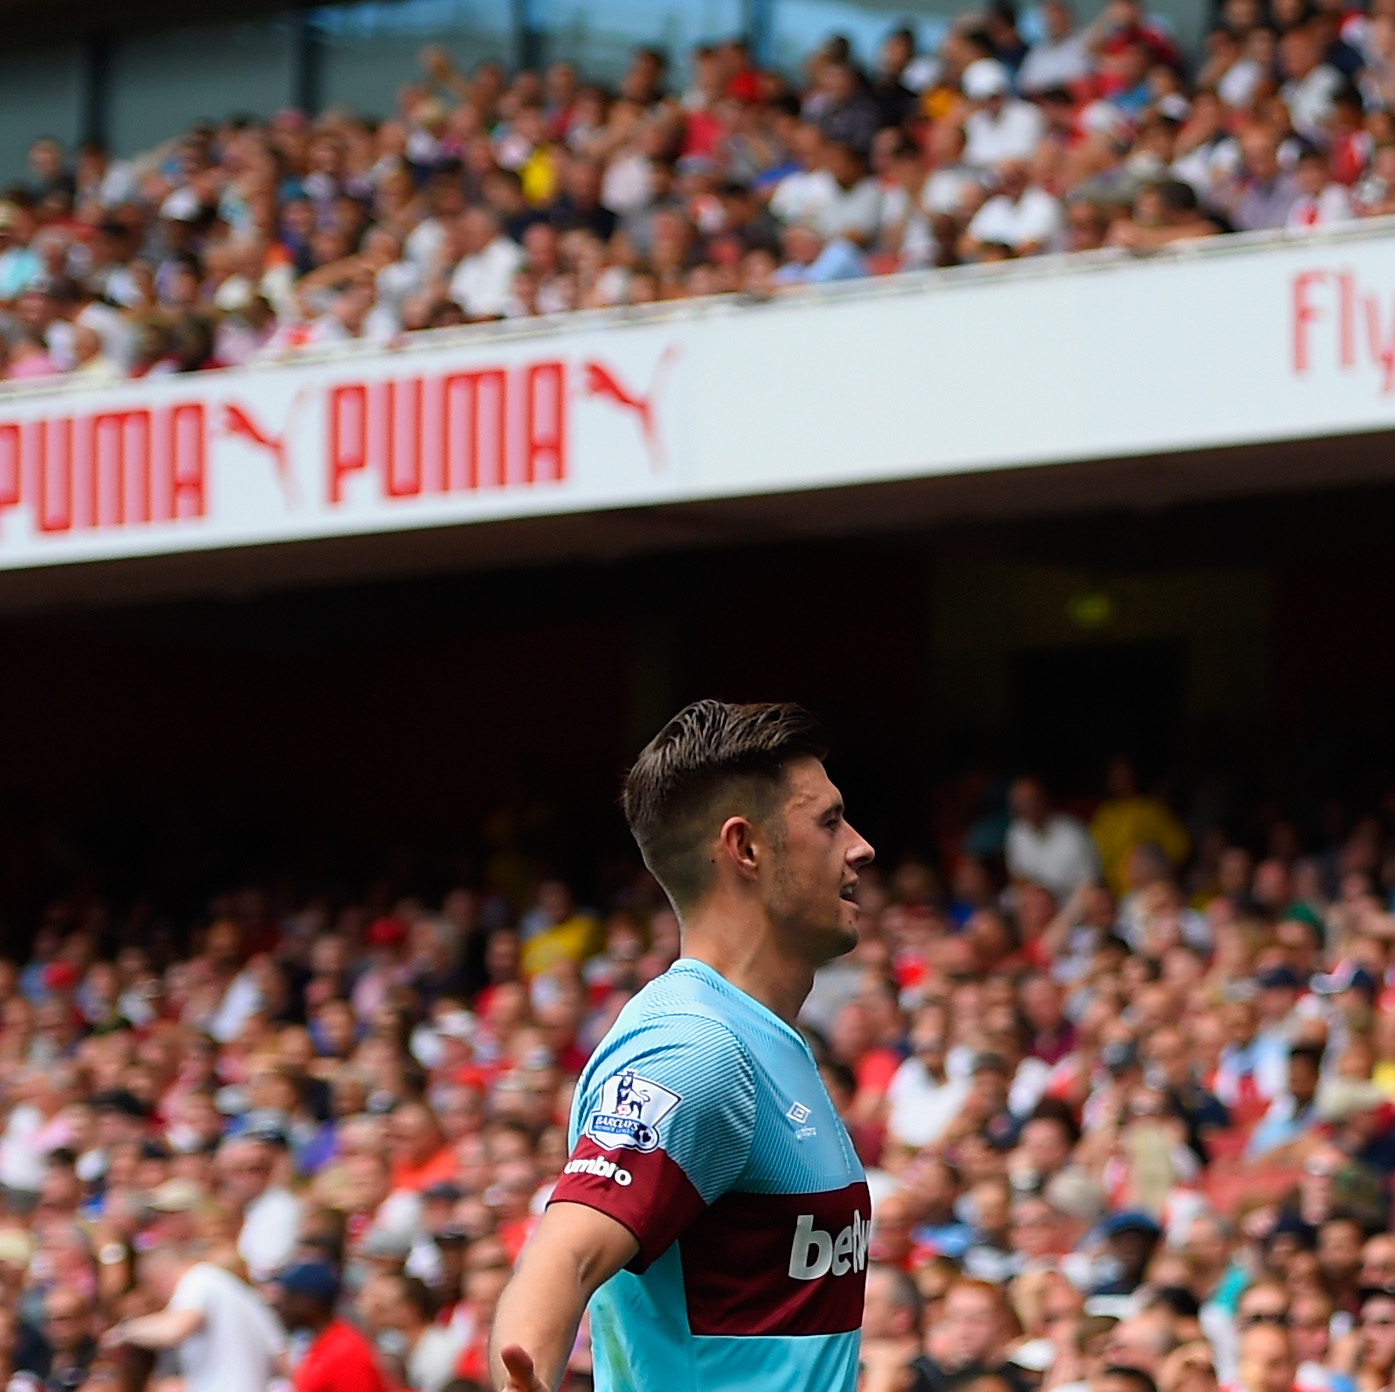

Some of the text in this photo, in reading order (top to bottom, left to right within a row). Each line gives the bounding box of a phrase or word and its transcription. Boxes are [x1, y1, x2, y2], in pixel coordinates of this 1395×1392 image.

[327, 361, 567, 507] PUMA
[595, 1116, 640, 1131] BARCLAYS
[564, 1156, 632, 1187] umbro
